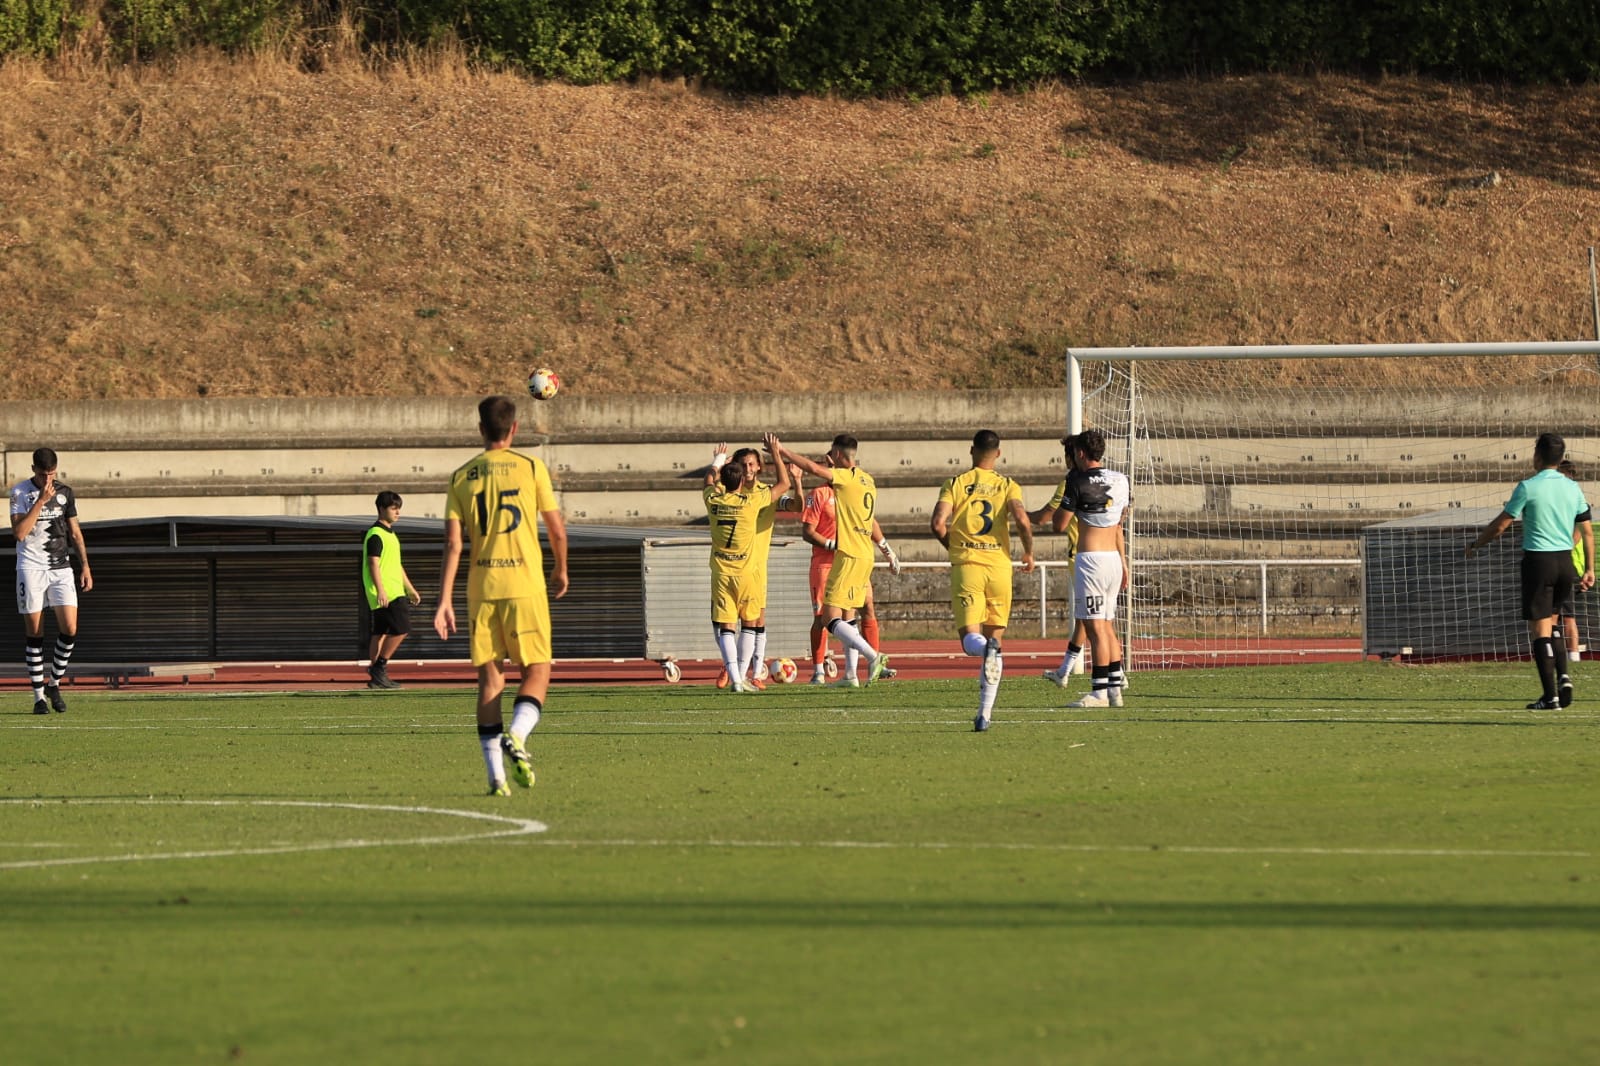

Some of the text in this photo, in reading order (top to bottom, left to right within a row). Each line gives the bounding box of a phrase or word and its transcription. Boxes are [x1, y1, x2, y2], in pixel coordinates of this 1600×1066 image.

[474, 488, 522, 537] 15
[864, 492, 874, 521] 9
[970, 500, 993, 536] 3
[717, 520, 738, 548] 7
[20, 582, 26, 597] 3
